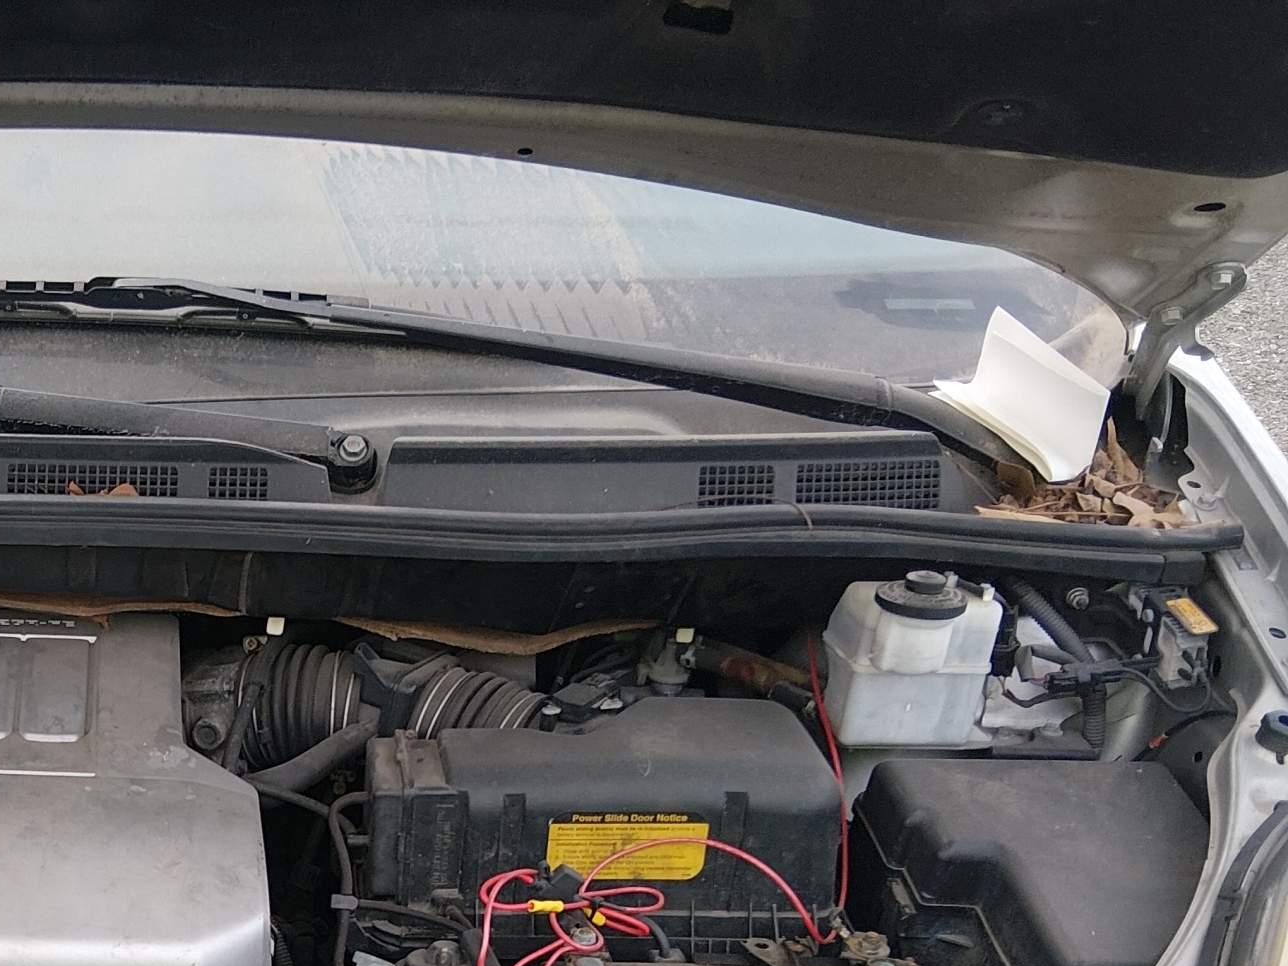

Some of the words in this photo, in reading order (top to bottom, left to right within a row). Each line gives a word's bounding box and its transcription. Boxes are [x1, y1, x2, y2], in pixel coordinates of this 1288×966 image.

[572, 814, 602, 823] Power
[604, 813, 629, 823] Slide
[630, 814, 655, 823] Door
[656, 814, 689, 823] Notice
